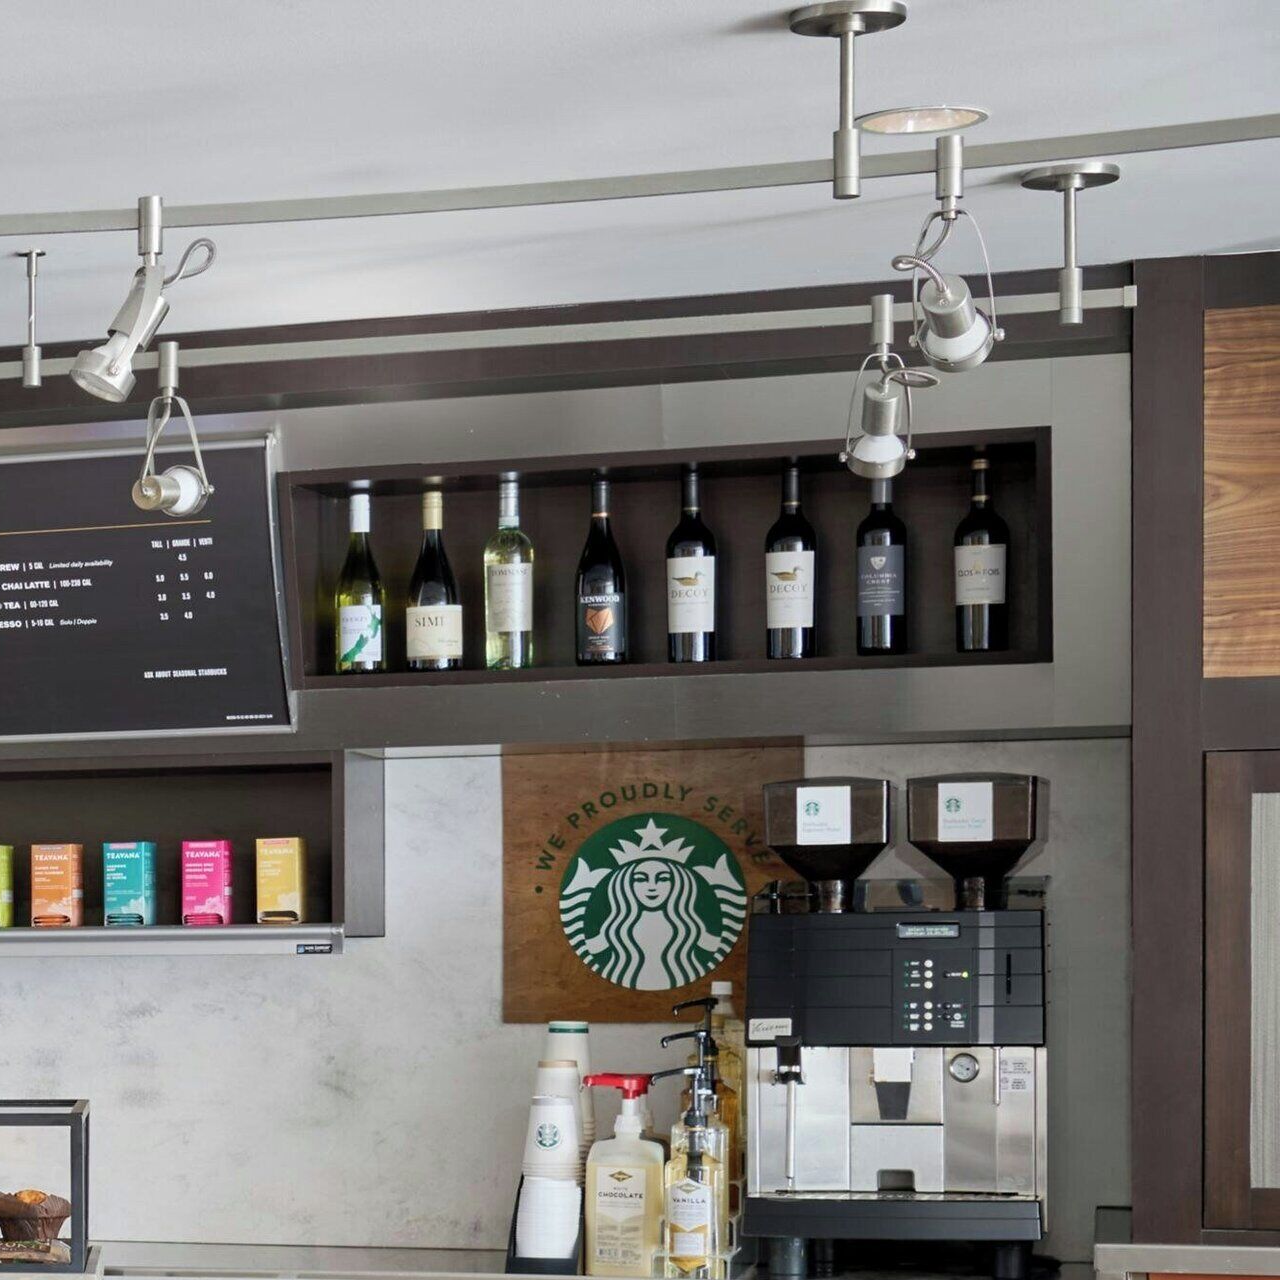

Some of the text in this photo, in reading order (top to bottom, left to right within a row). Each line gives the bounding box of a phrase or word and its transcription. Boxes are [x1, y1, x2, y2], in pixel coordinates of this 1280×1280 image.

[1, 582, 23, 591] CHAI
[24, 580, 50, 590] LATTE
[770, 583, 808, 593] DECOY
[580, 594, 620, 603] KENWOOD
[671, 588, 708, 599] DECOY
[3, 601, 21, 610] TEA
[414, 616, 445, 628] SIMI
[536, 782, 771, 872] WE PROUDLY SERVE
